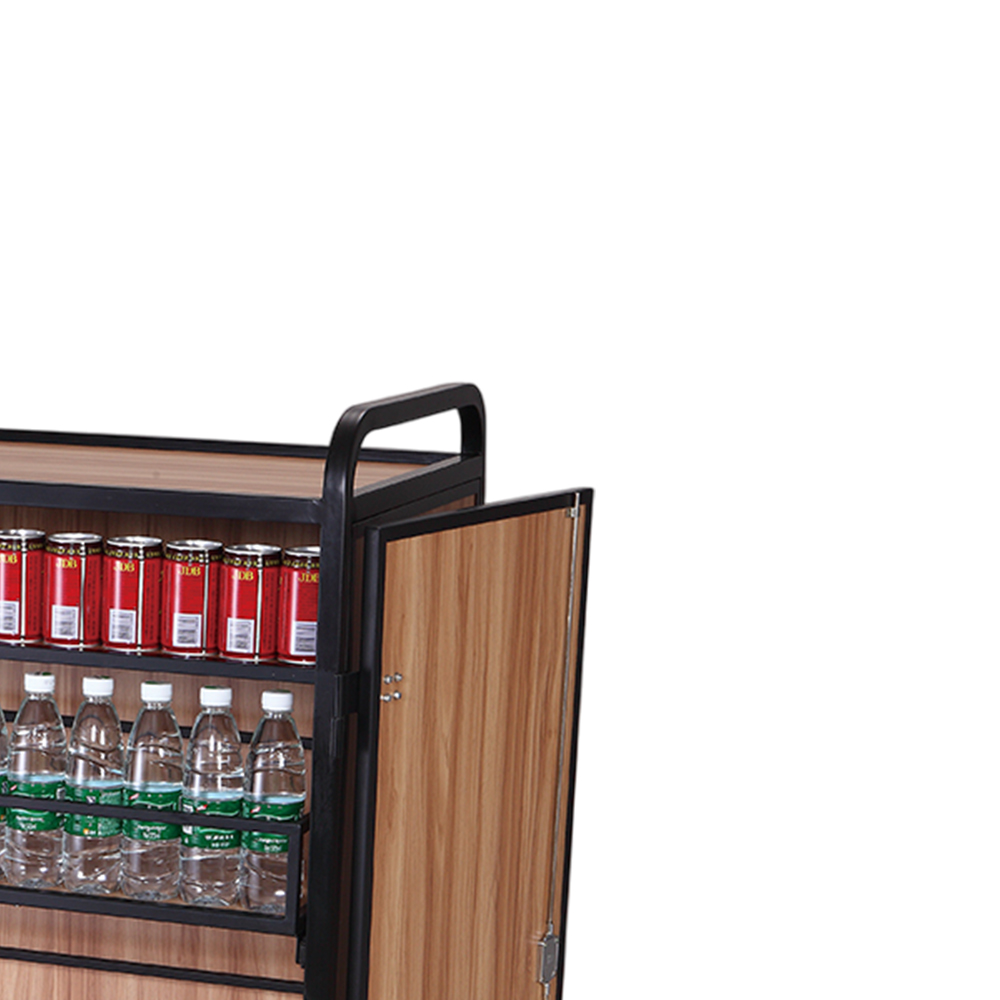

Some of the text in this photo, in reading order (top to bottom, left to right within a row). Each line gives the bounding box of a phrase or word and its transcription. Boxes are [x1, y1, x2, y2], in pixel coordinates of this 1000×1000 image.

[56, 559, 78, 568] JDB
[113, 562, 135, 572] JDB
[179, 566, 201, 576] JDB
[232, 571, 254, 581] JDB
